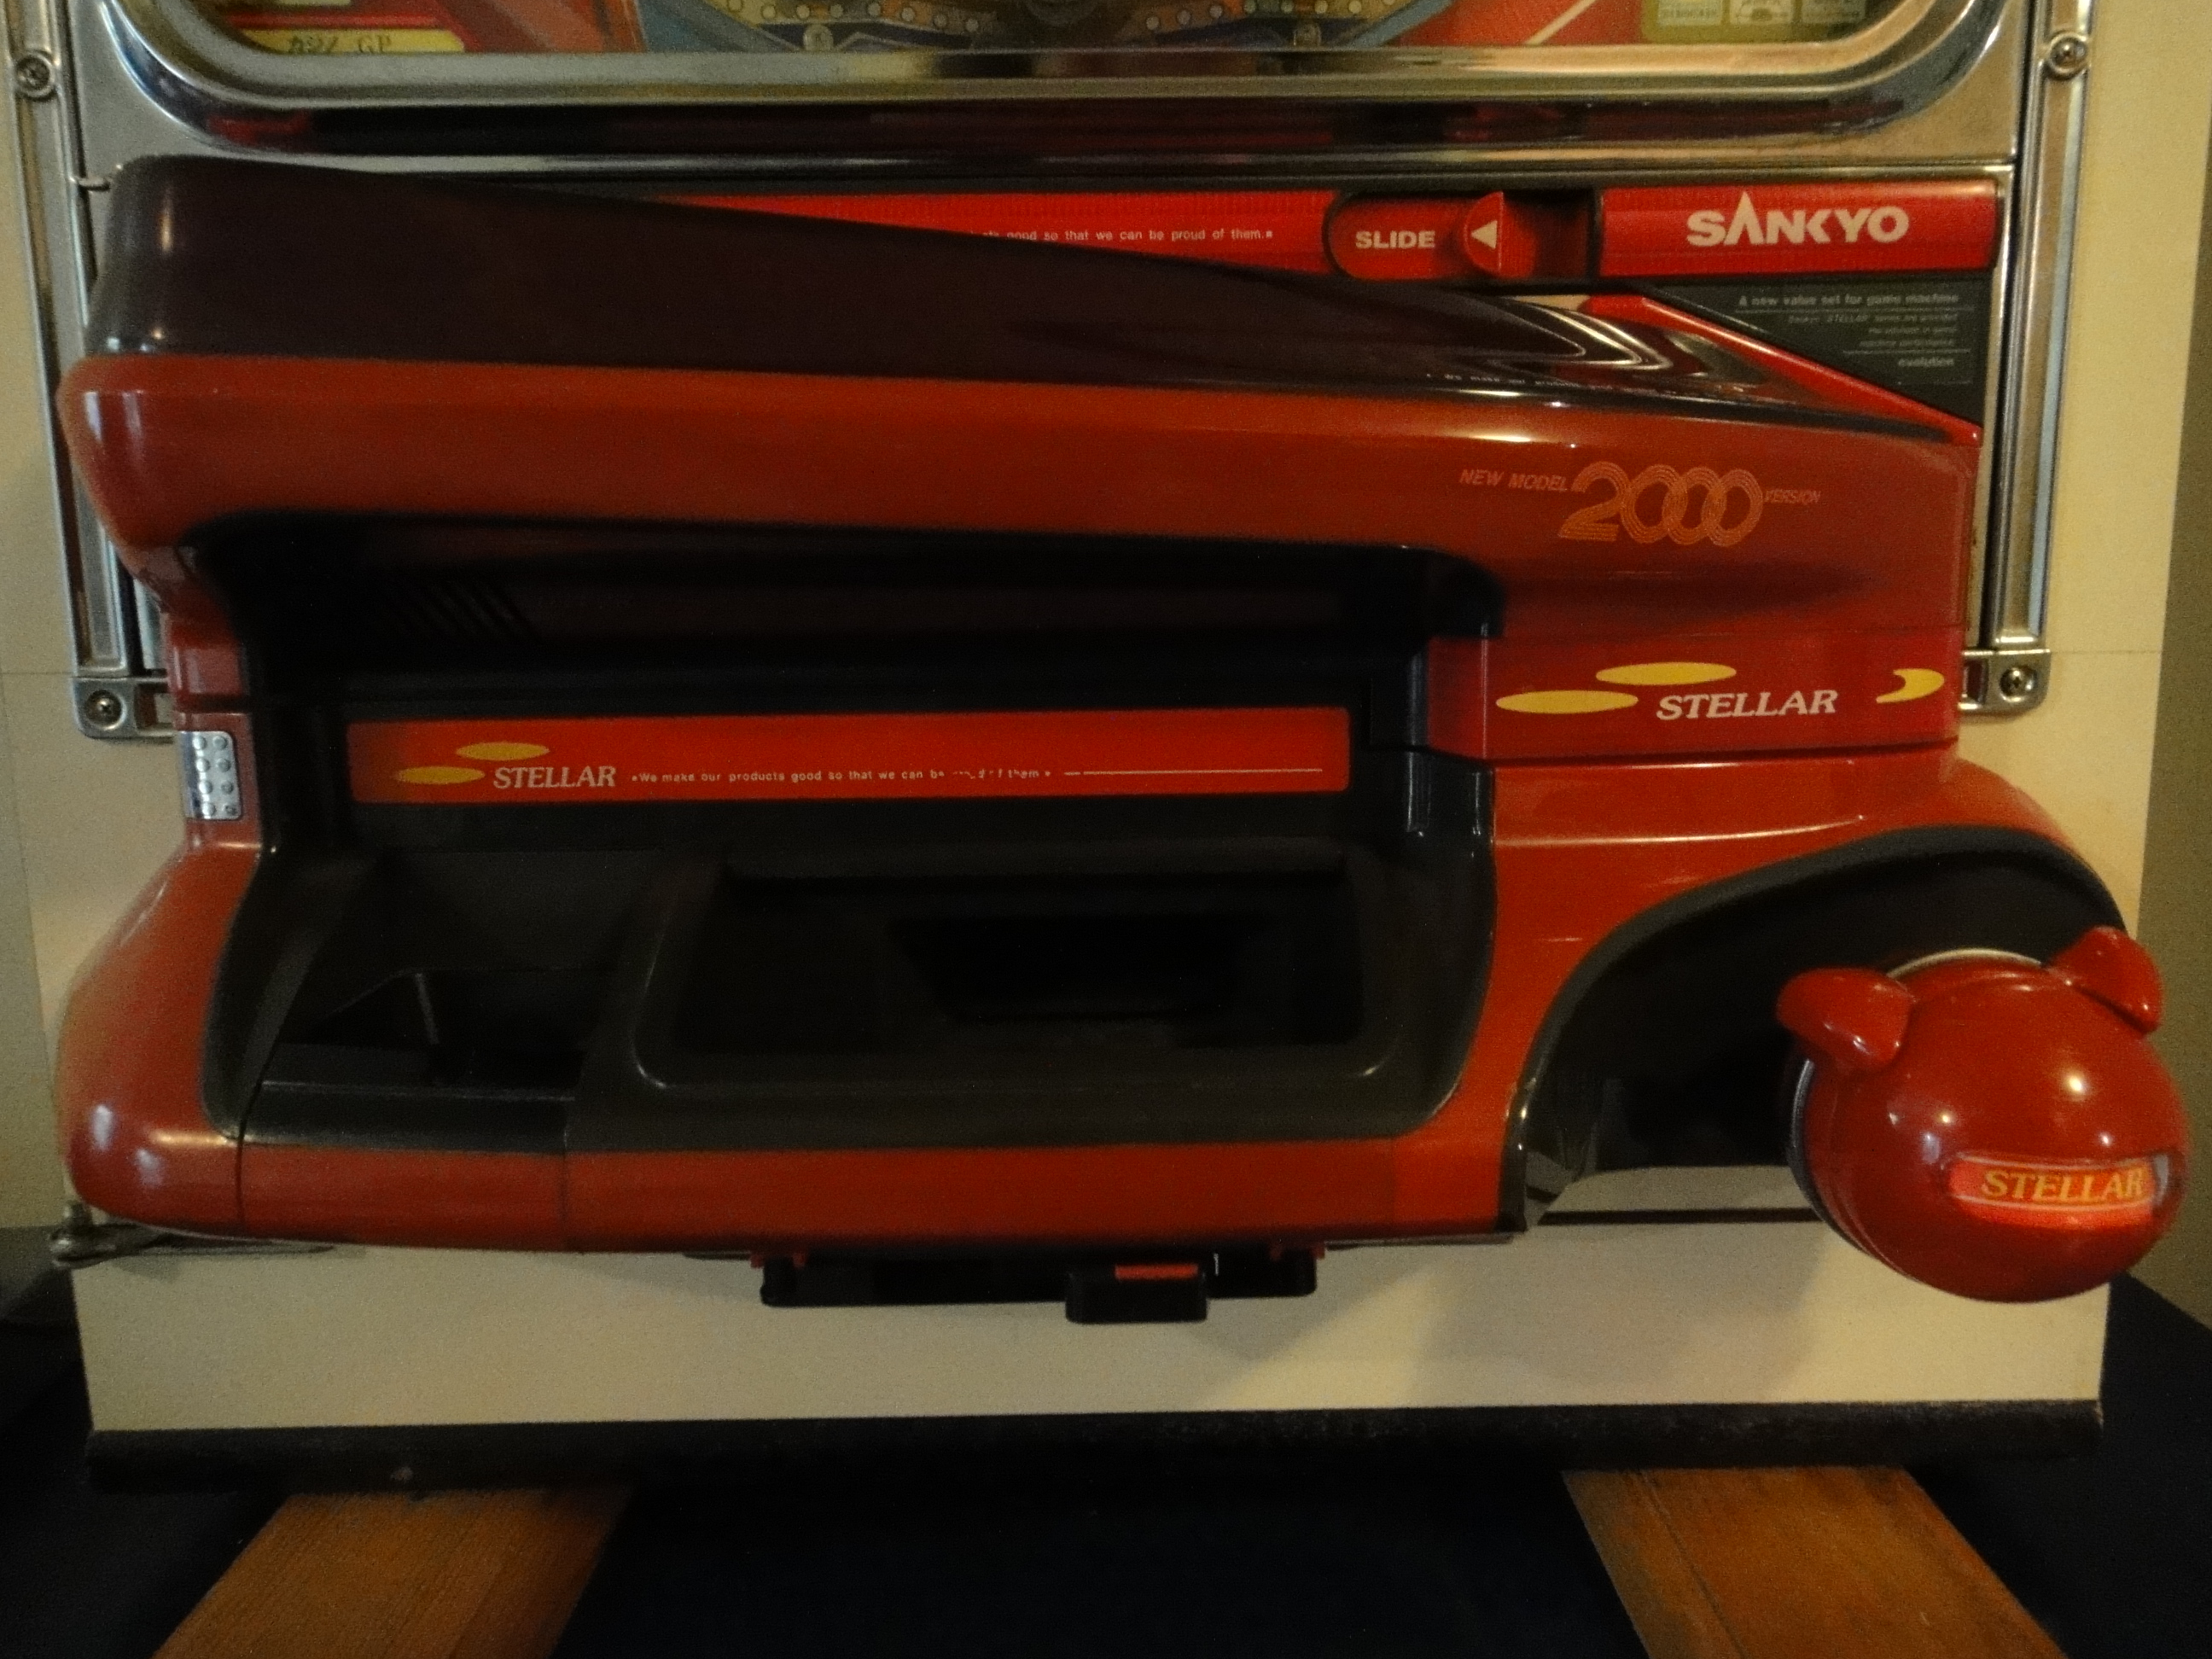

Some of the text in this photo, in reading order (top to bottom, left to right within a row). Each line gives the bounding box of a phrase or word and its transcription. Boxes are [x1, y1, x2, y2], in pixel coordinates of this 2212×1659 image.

[1686, 190, 1910, 247] SANKYO
[1044, 231, 1059, 241] so
[1065, 230, 1089, 241] that
[1095, 231, 1114, 241] we
[1120, 230, 1143, 241] can
[1149, 230, 1165, 241] be
[1171, 230, 1206, 242] proud
[1212, 228, 1225, 241] of
[1355, 229, 1436, 250] SLIDE
[1458, 460, 1822, 548] NEW MODEL 2000 VERSION
[1656, 689, 1839, 721] STELLAR
[492, 765, 617, 789] STELLAR
[637, 772, 657, 783] We
[661, 772, 696, 783] make
[701, 772, 721, 782] our
[728, 771, 785, 783] products
[790, 771, 822, 783] good
[828, 771, 843, 781] so
[848, 770, 872, 781] that
[877, 771, 895, 780] we
[900, 771, 924, 780] can
[1979, 1166, 2146, 1202] STELLAR
